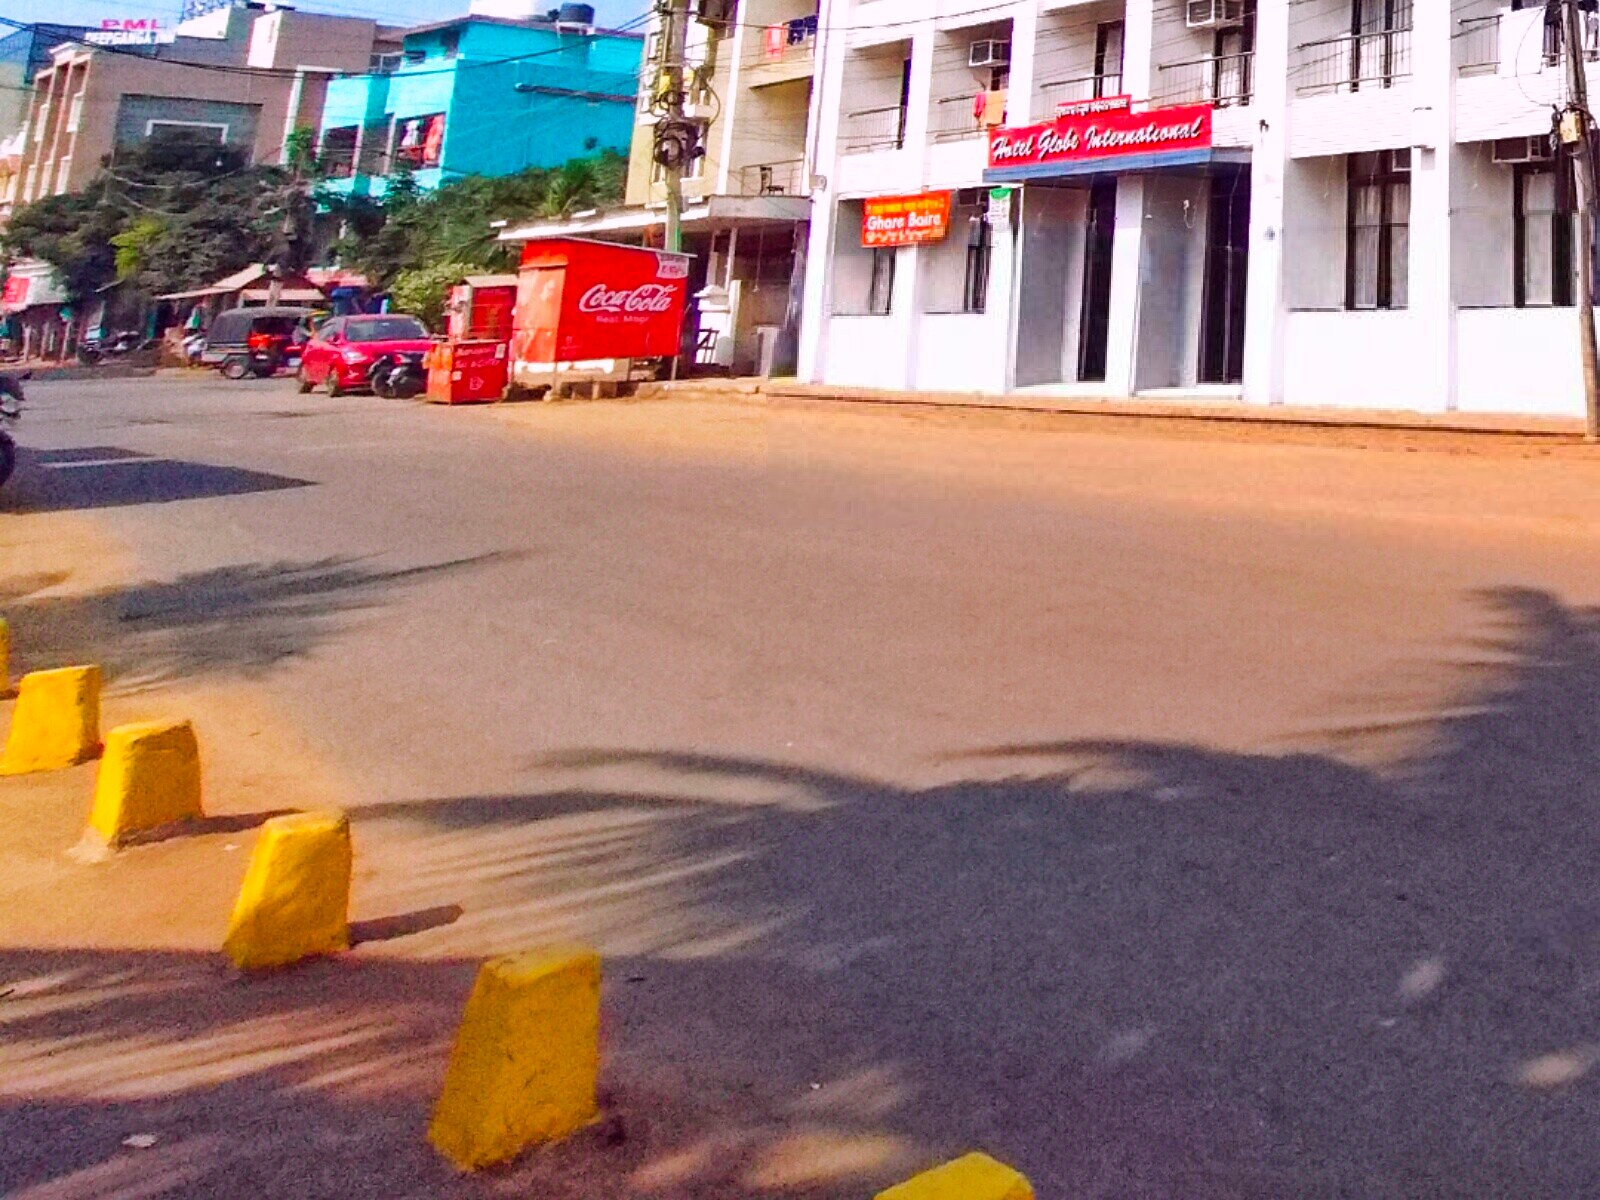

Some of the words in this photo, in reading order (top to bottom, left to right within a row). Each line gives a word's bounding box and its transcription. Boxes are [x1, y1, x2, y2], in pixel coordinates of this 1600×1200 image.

[991, 134, 1034, 161] Hotel
[1084, 116, 1204, 151] International
[579, 284, 678, 313] Coca-Cola
